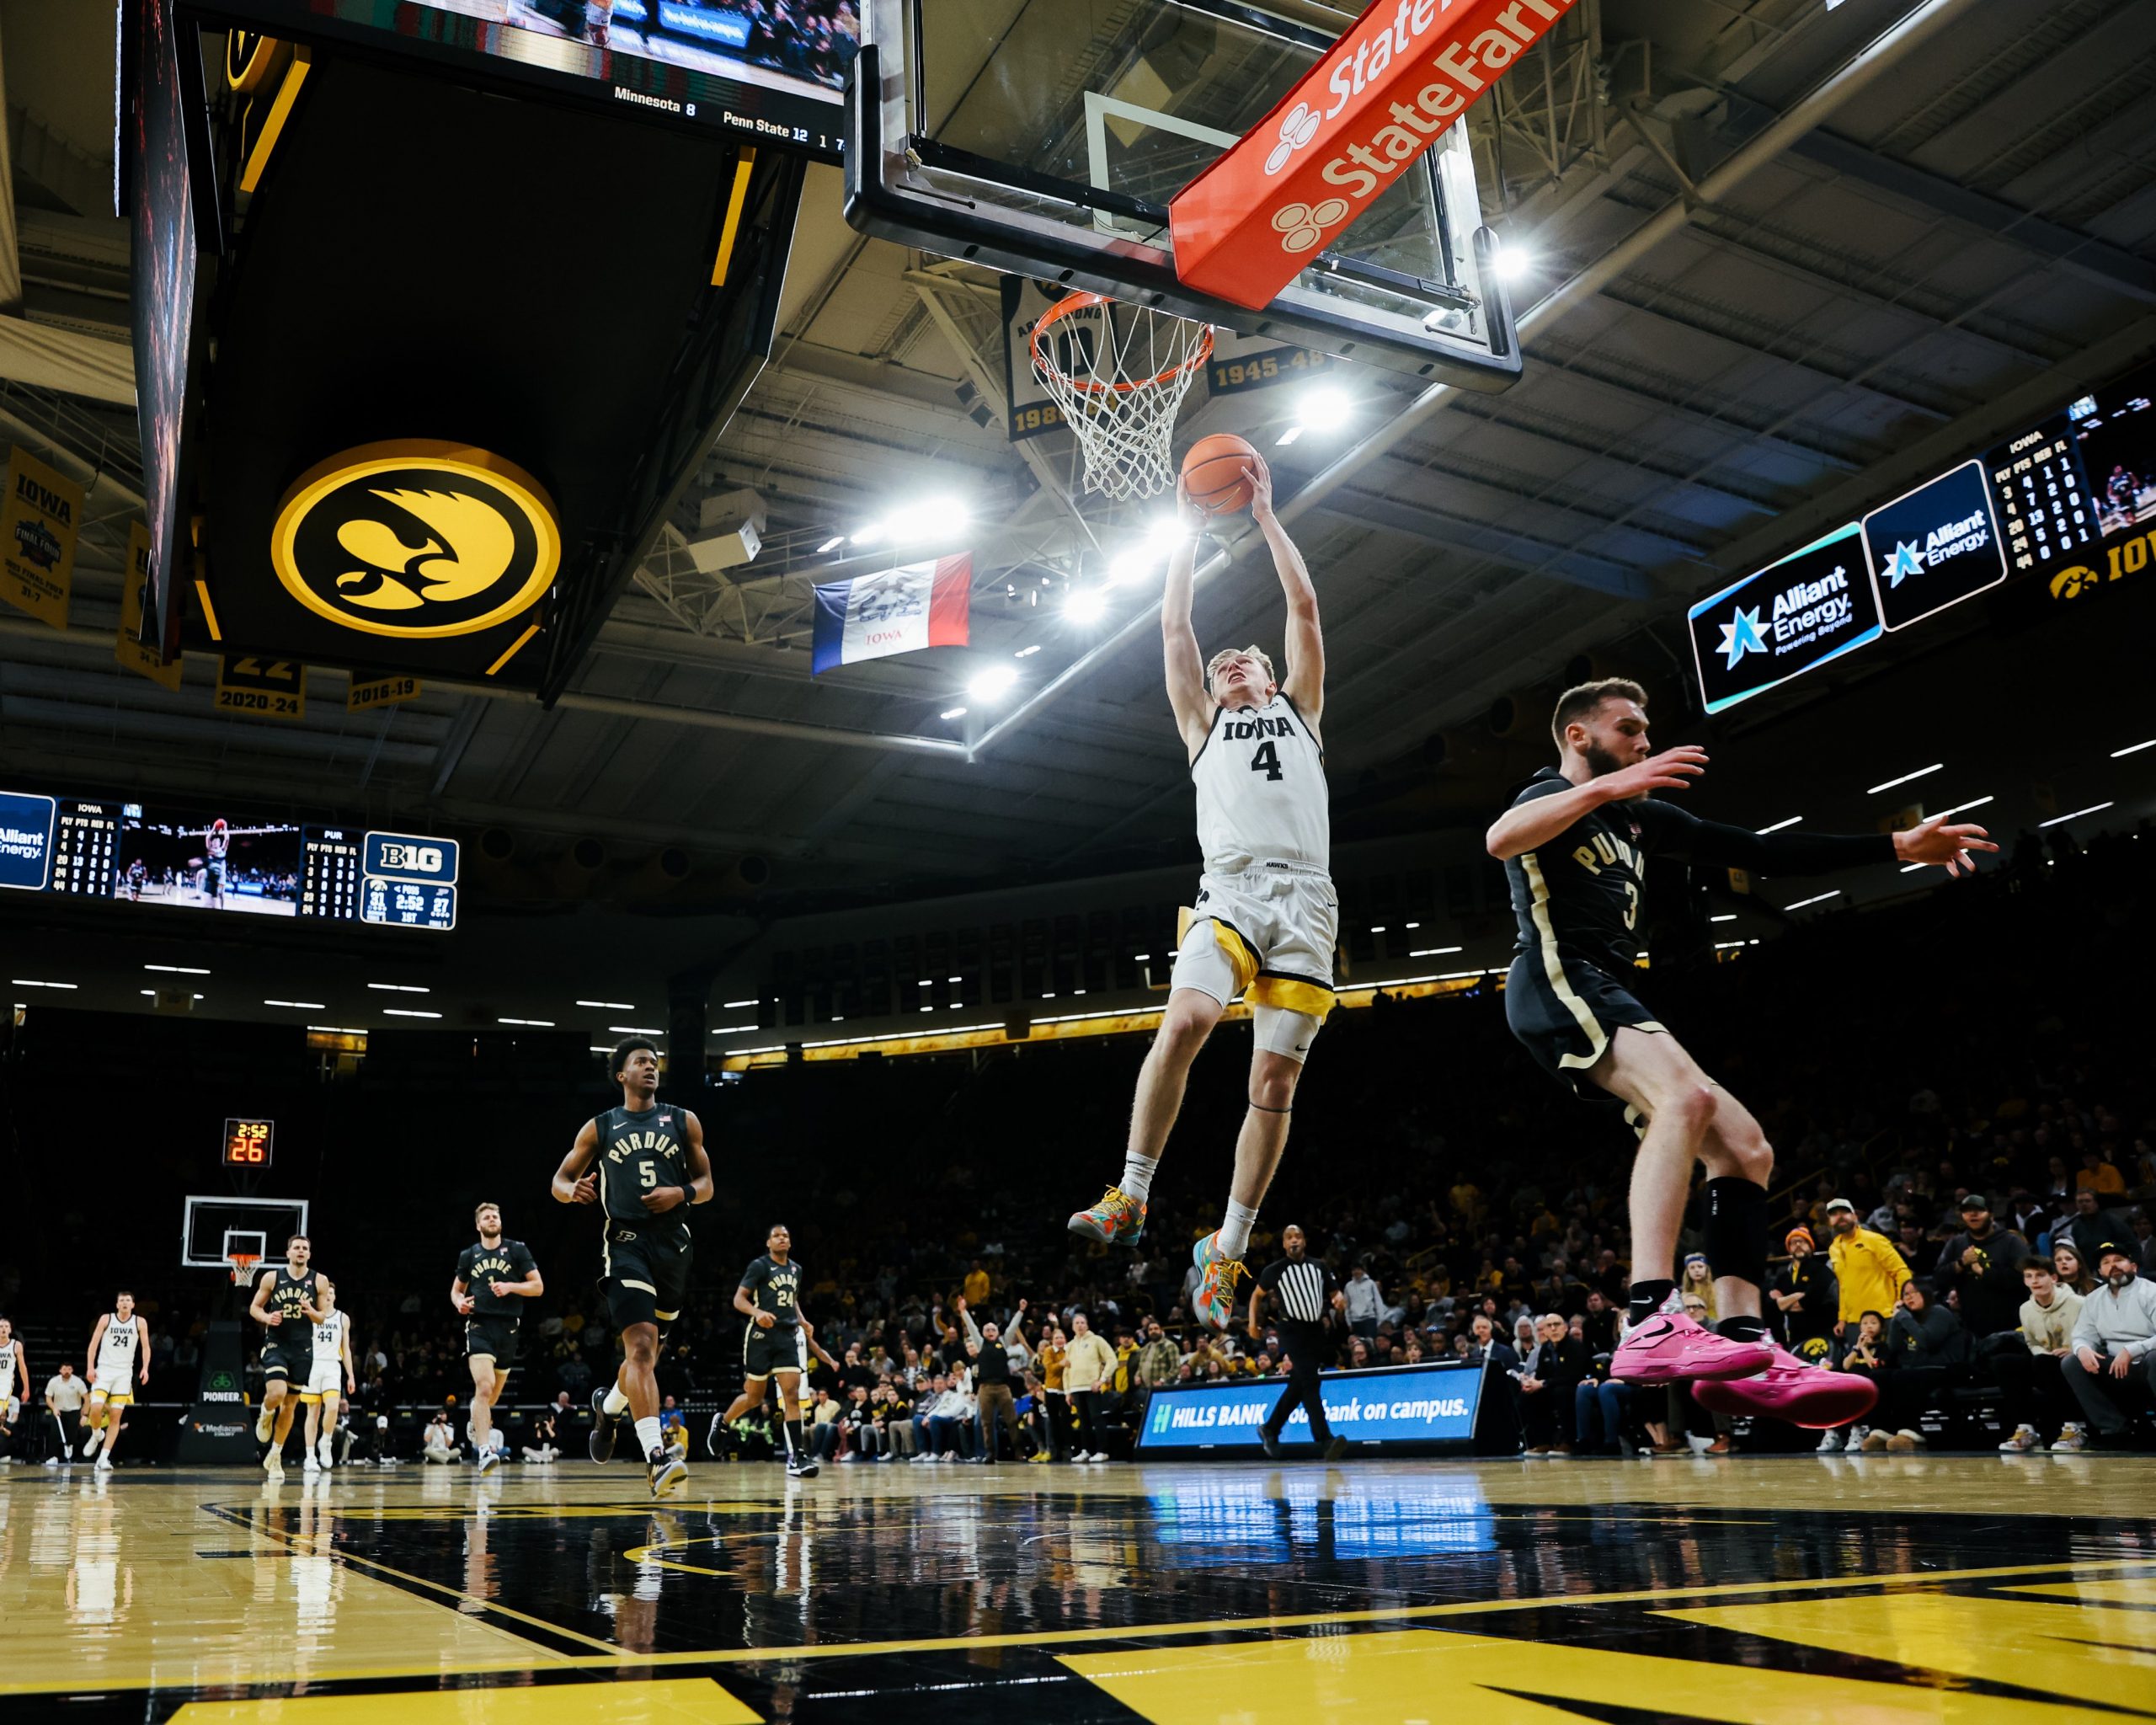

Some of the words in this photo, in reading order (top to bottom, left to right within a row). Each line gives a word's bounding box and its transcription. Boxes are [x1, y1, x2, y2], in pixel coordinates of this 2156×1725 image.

[1326, 0, 1453, 120] State
[614, 86, 680, 113] Minnesota
[686, 103, 696, 116] 8
[723, 111, 754, 130] Penn
[755, 119, 789, 137] State
[792, 126, 808, 142] 12
[819, 135, 826, 148] 1
[2009, 430, 2043, 453] IOWA
[2003, 486, 2013, 499] 3
[2023, 475, 2033, 489] 4
[2043, 465, 2053, 479] 1
[2060, 457, 2071, 472] 1
[16, 473, 72, 523] IOWA
[2025, 492, 2036, 506] 7
[2047, 482, 2058, 497] 2
[2064, 473, 2075, 488] 0
[2028, 509, 2045, 526] 13
[2052, 500, 2063, 515] 2
[2068, 492, 2080, 506] 0
[1925, 510, 1986, 552] Alliant
[2035, 526, 2047, 542] 5
[2056, 518, 2068, 532] 2
[2073, 510, 2084, 524] 0
[15, 526, 39, 547] FINAL
[40, 537, 61, 561] FOUR
[2040, 545, 2051, 559] 0
[2061, 535, 2072, 550] 0
[2079, 528, 2089, 542] 1
[2107, 529, 2156, 582] IO
[1772, 565, 1849, 622] Alliant
[865, 630, 902, 646] IOWA
[1775, 631, 1817, 656] Powering
[1817, 612, 1853, 636] Beyond
[221, 691, 299, 713] 2020-24
[1223, 716, 1296, 741] IOWA
[1251, 740, 1283, 782] 4
[77, 804, 102, 814] IOWA
[61, 829, 69, 839] 3
[77, 830, 85, 841] 4
[93, 831, 99, 842] 1
[106, 833, 112, 844] 1
[324, 830, 343, 841] PUR
[60, 841, 67, 852] 4
[77, 843, 83, 853] 7
[92, 844, 99, 855] 2
[104, 846, 111, 857] 0
[56, 854, 68, 865] 20
[72, 856, 84, 867] 13
[90, 857, 97, 868] 2
[309, 854, 314, 865] 1
[350, 858, 355, 869] 1
[1266, 862, 1289, 870] HAWKS
[88, 870, 96, 881] 2
[53, 880, 66, 891] 44
[87, 883, 94, 894] 0
[100, 884, 106, 895] 1
[334, 906, 339, 917] 1
[347, 895, 352, 906] 1
[370, 891, 385, 906] 31
[396, 894, 424, 911] 2:52
[433, 897, 449, 913] 27
[1623, 881, 1638, 931] 3
[237, 1124, 268, 1139] 2:52
[232, 1137, 262, 1162] 26
[608, 1130, 680, 1164] PURDUE
[638, 1160, 657, 1188] 5
[471, 1258, 512, 1279] PURDUE
[777, 1290, 794, 1308] 24
[282, 1303, 302, 1320] 23
[110, 1327, 133, 1335] IOWA
[113, 1335, 128, 1348] 24
[318, 1331, 333, 1343] 44
[1171, 1406, 1218, 1429] HILLS
[1217, 1403, 1268, 1427] BANK
[1288, 1407, 1309, 1424] ou
[1363, 1403, 1386, 1420] on
[1390, 1397, 1469, 1424] campus.
[205, 1423, 243, 1433] Mediacom
